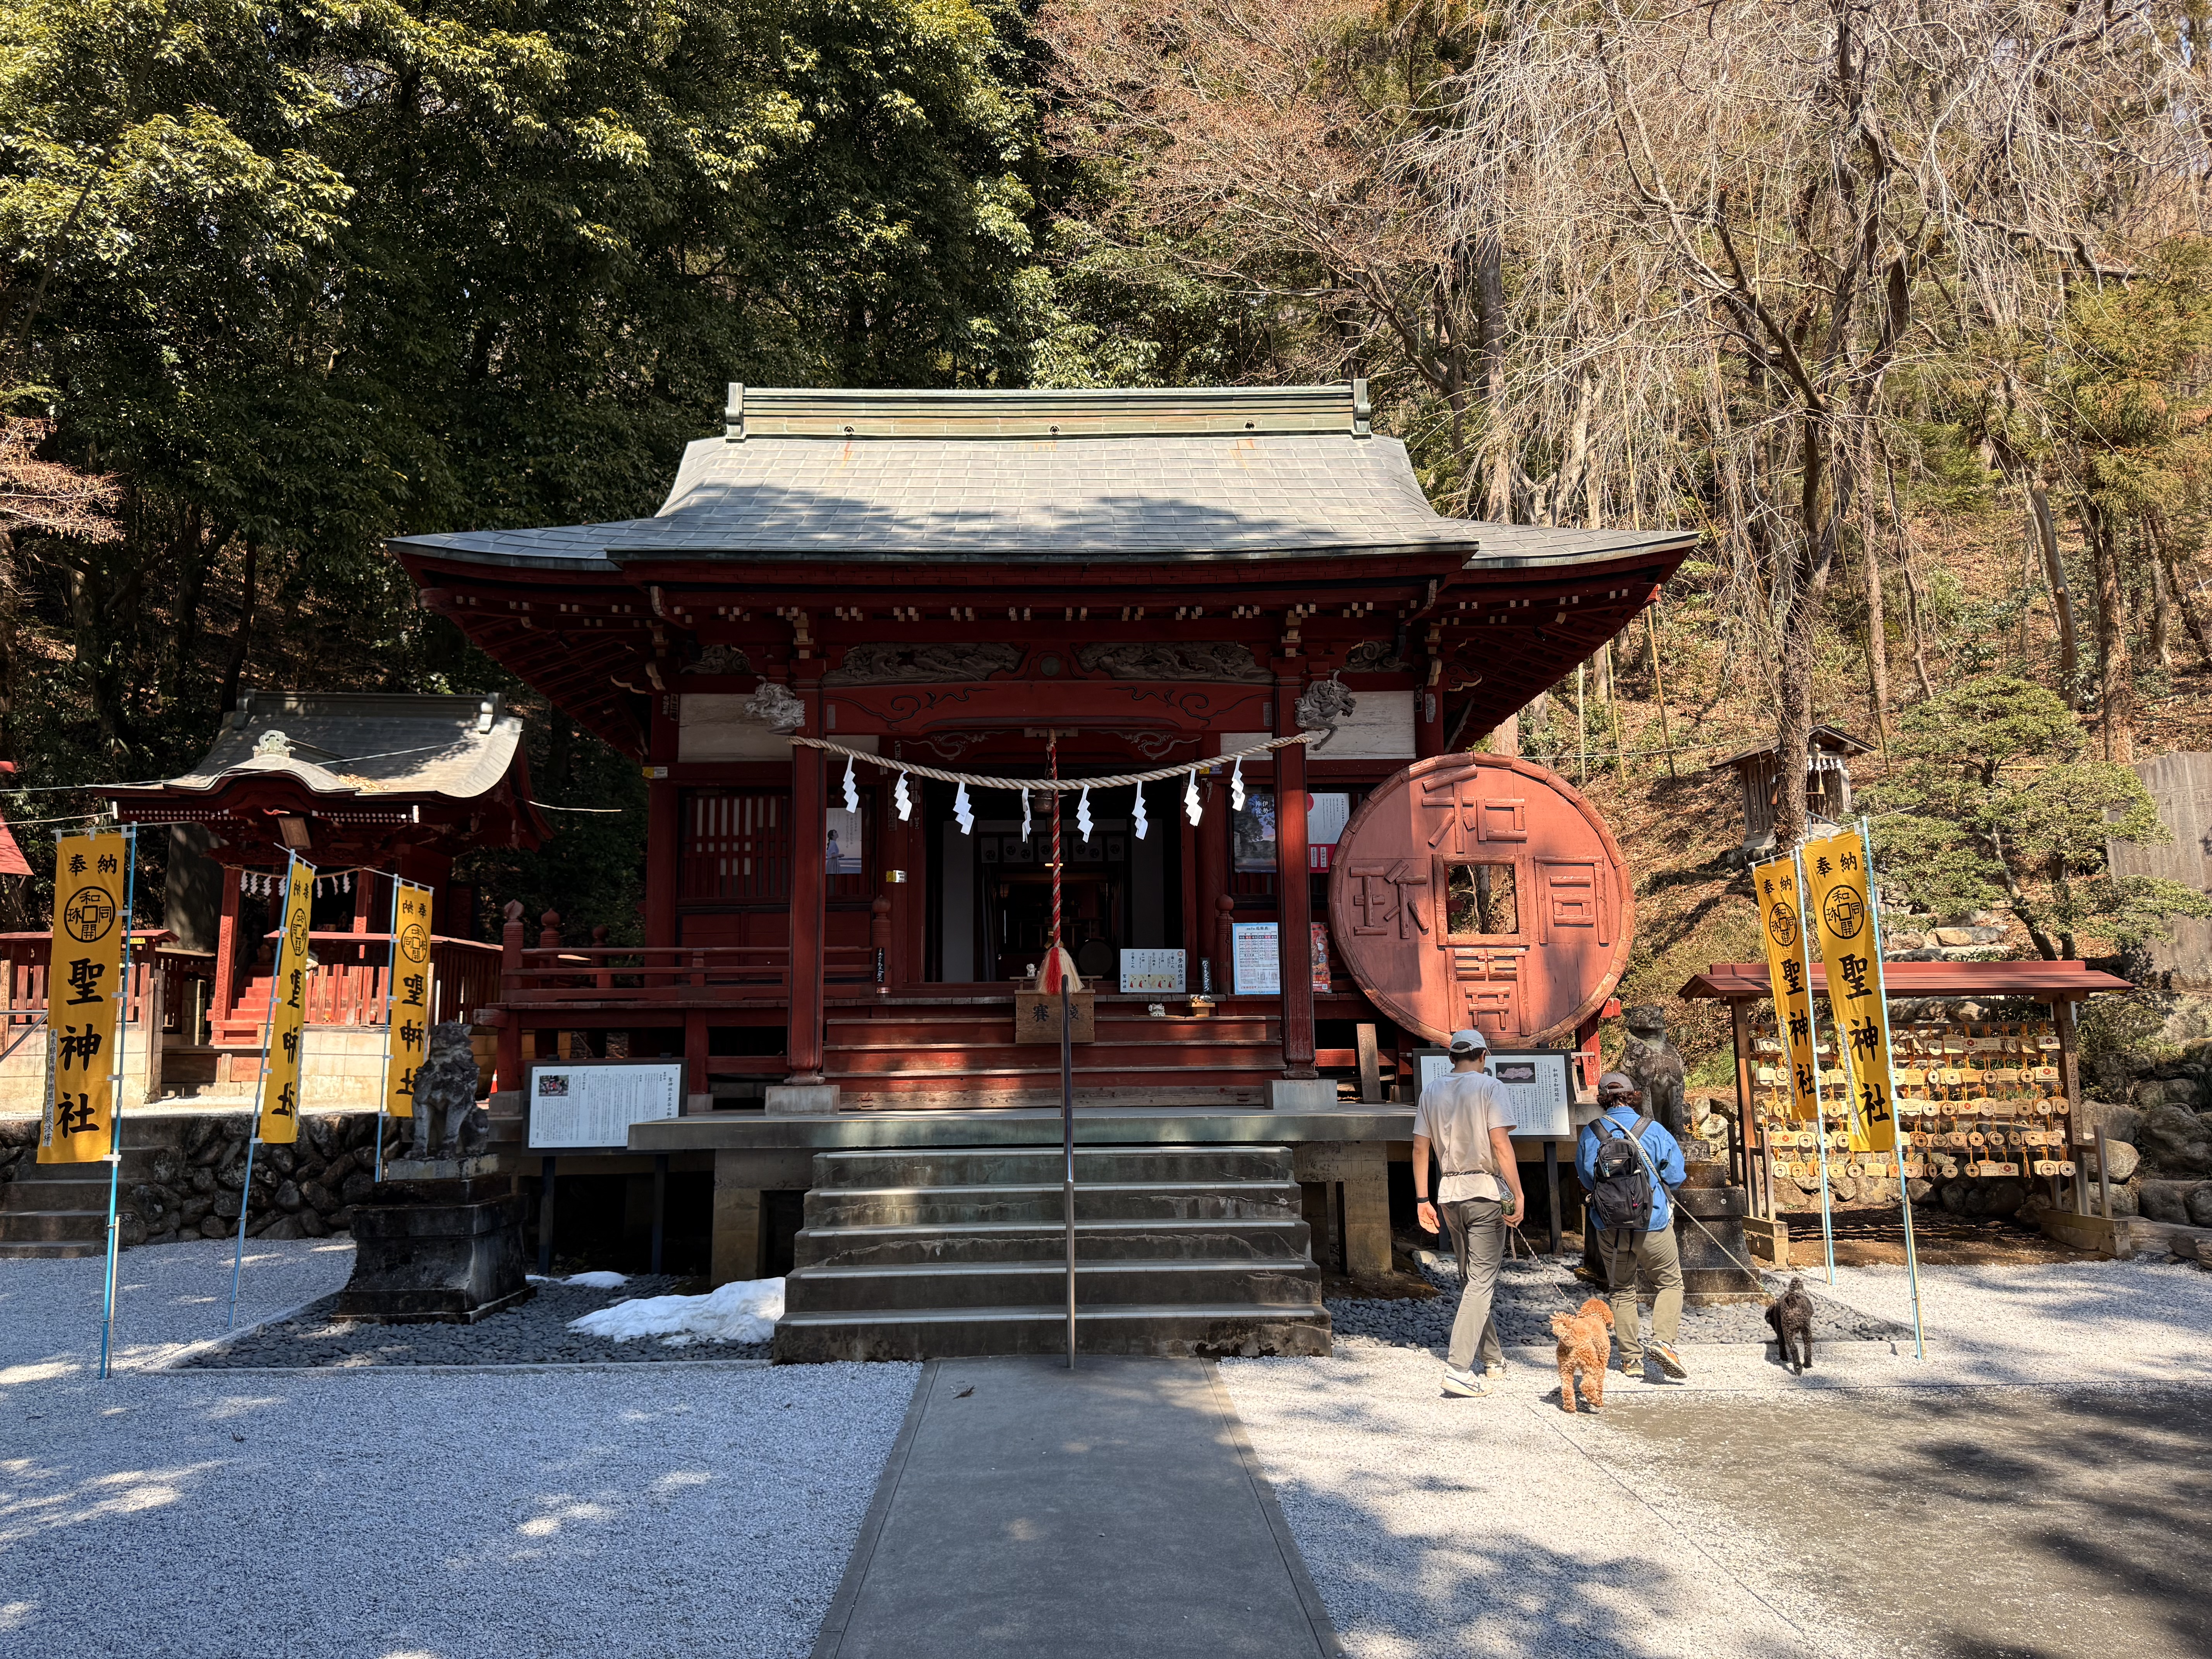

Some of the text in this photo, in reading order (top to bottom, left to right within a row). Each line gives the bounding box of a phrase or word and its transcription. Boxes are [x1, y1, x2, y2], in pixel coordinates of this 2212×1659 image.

[1263, 801, 1269, 814] 伊勢
[69, 854, 118, 877] 奉納
[1816, 852, 1858, 879] 奉納
[1764, 875, 1793, 897] 奉納
[1781, 958, 1815, 1099] 聖神社
[1838, 953, 1891, 1127] 聖神社
[56, 958, 106, 1139] 聖神社
